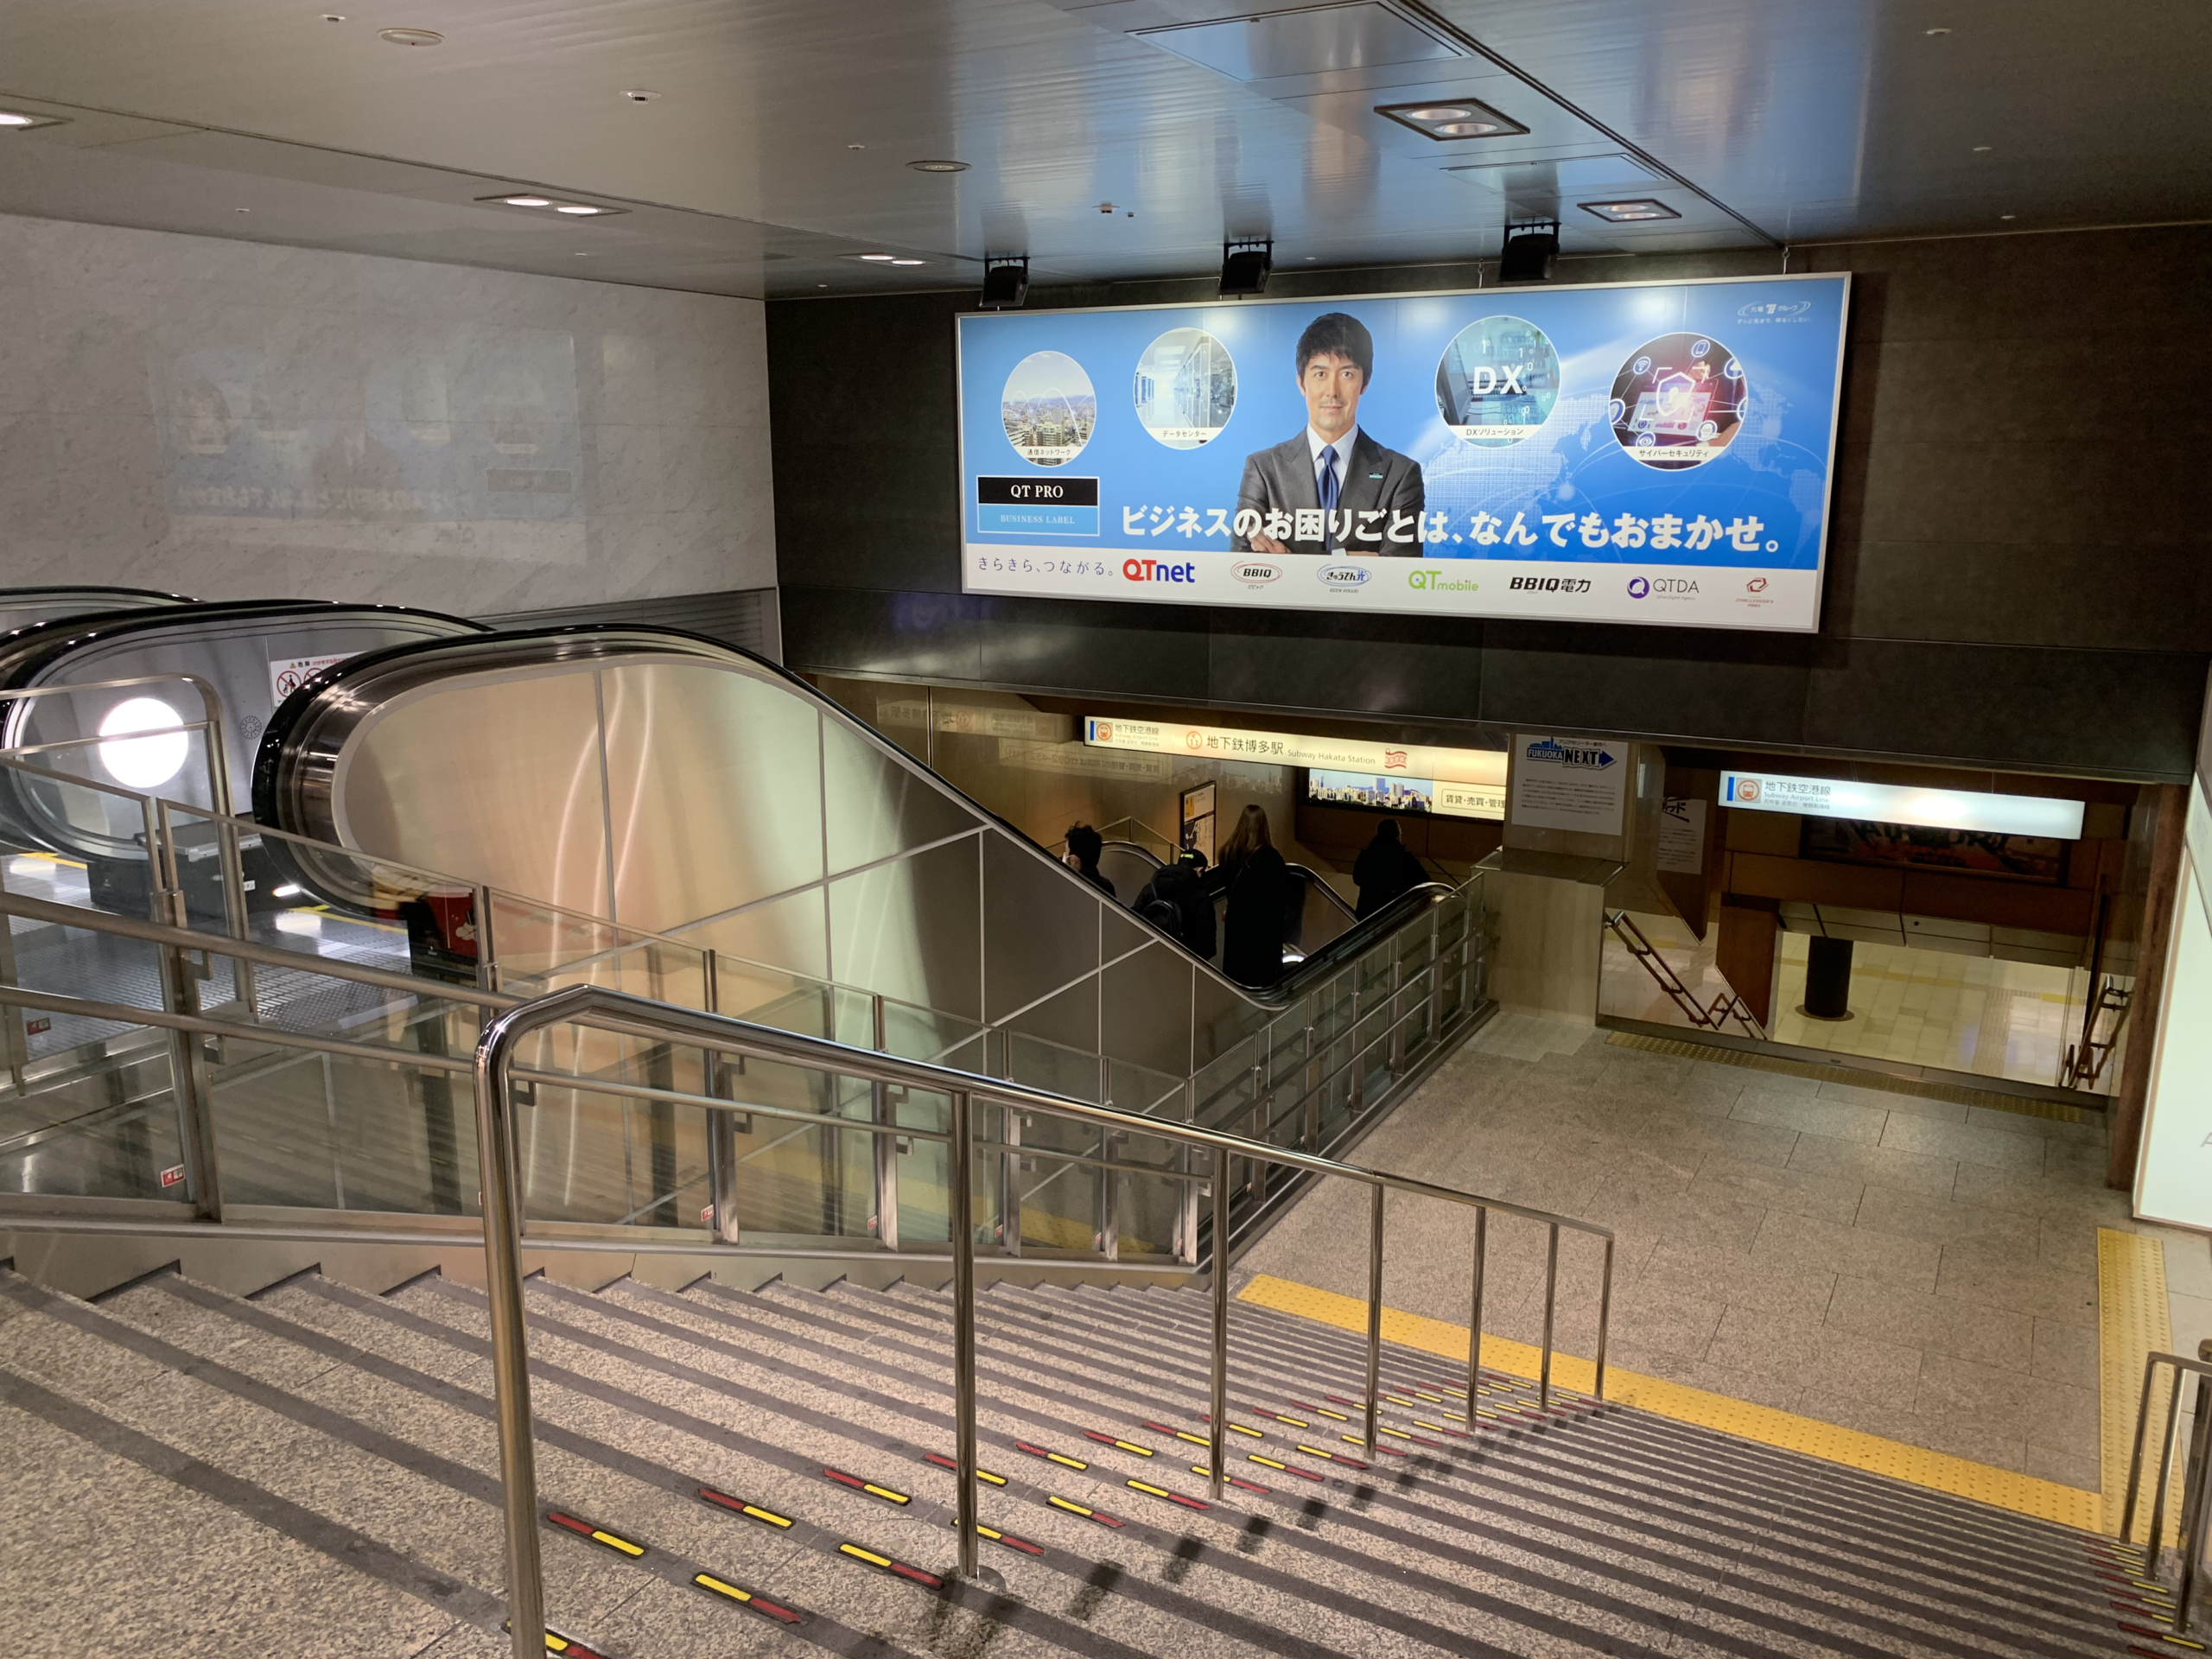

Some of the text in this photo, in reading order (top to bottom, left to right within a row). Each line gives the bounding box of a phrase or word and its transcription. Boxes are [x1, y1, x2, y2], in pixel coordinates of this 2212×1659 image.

[1472, 365, 1524, 395] DX
[1161, 429, 1207, 438] データセンター
[1465, 428, 1524, 436] DXソリューション
[1638, 448, 1709, 459] サイバーセキュリティ
[1010, 484, 1065, 499] QT PRO
[1000, 514, 1076, 524] BUSINESS LABEL
[1122, 558, 1196, 583] QTnet
[1243, 568, 1272, 579] BBIQ
[1509, 576, 1592, 594] BBIQ電力
[1652, 578, 1700, 594] QTDA
[1115, 723, 1160, 736] 地下鉄空港線
[1190, 738, 1199, 747] 11
[1206, 734, 1284, 756] 地下鉄博多駅
[1287, 749, 1376, 765] Subway Hakata Station
[1528, 748, 1599, 766] FUKUOKA NEXT
[1764, 780, 1832, 796] 地下鉄空港線
[1764, 791, 1789, 800] Subway
[1790, 793, 1815, 803] Airport
